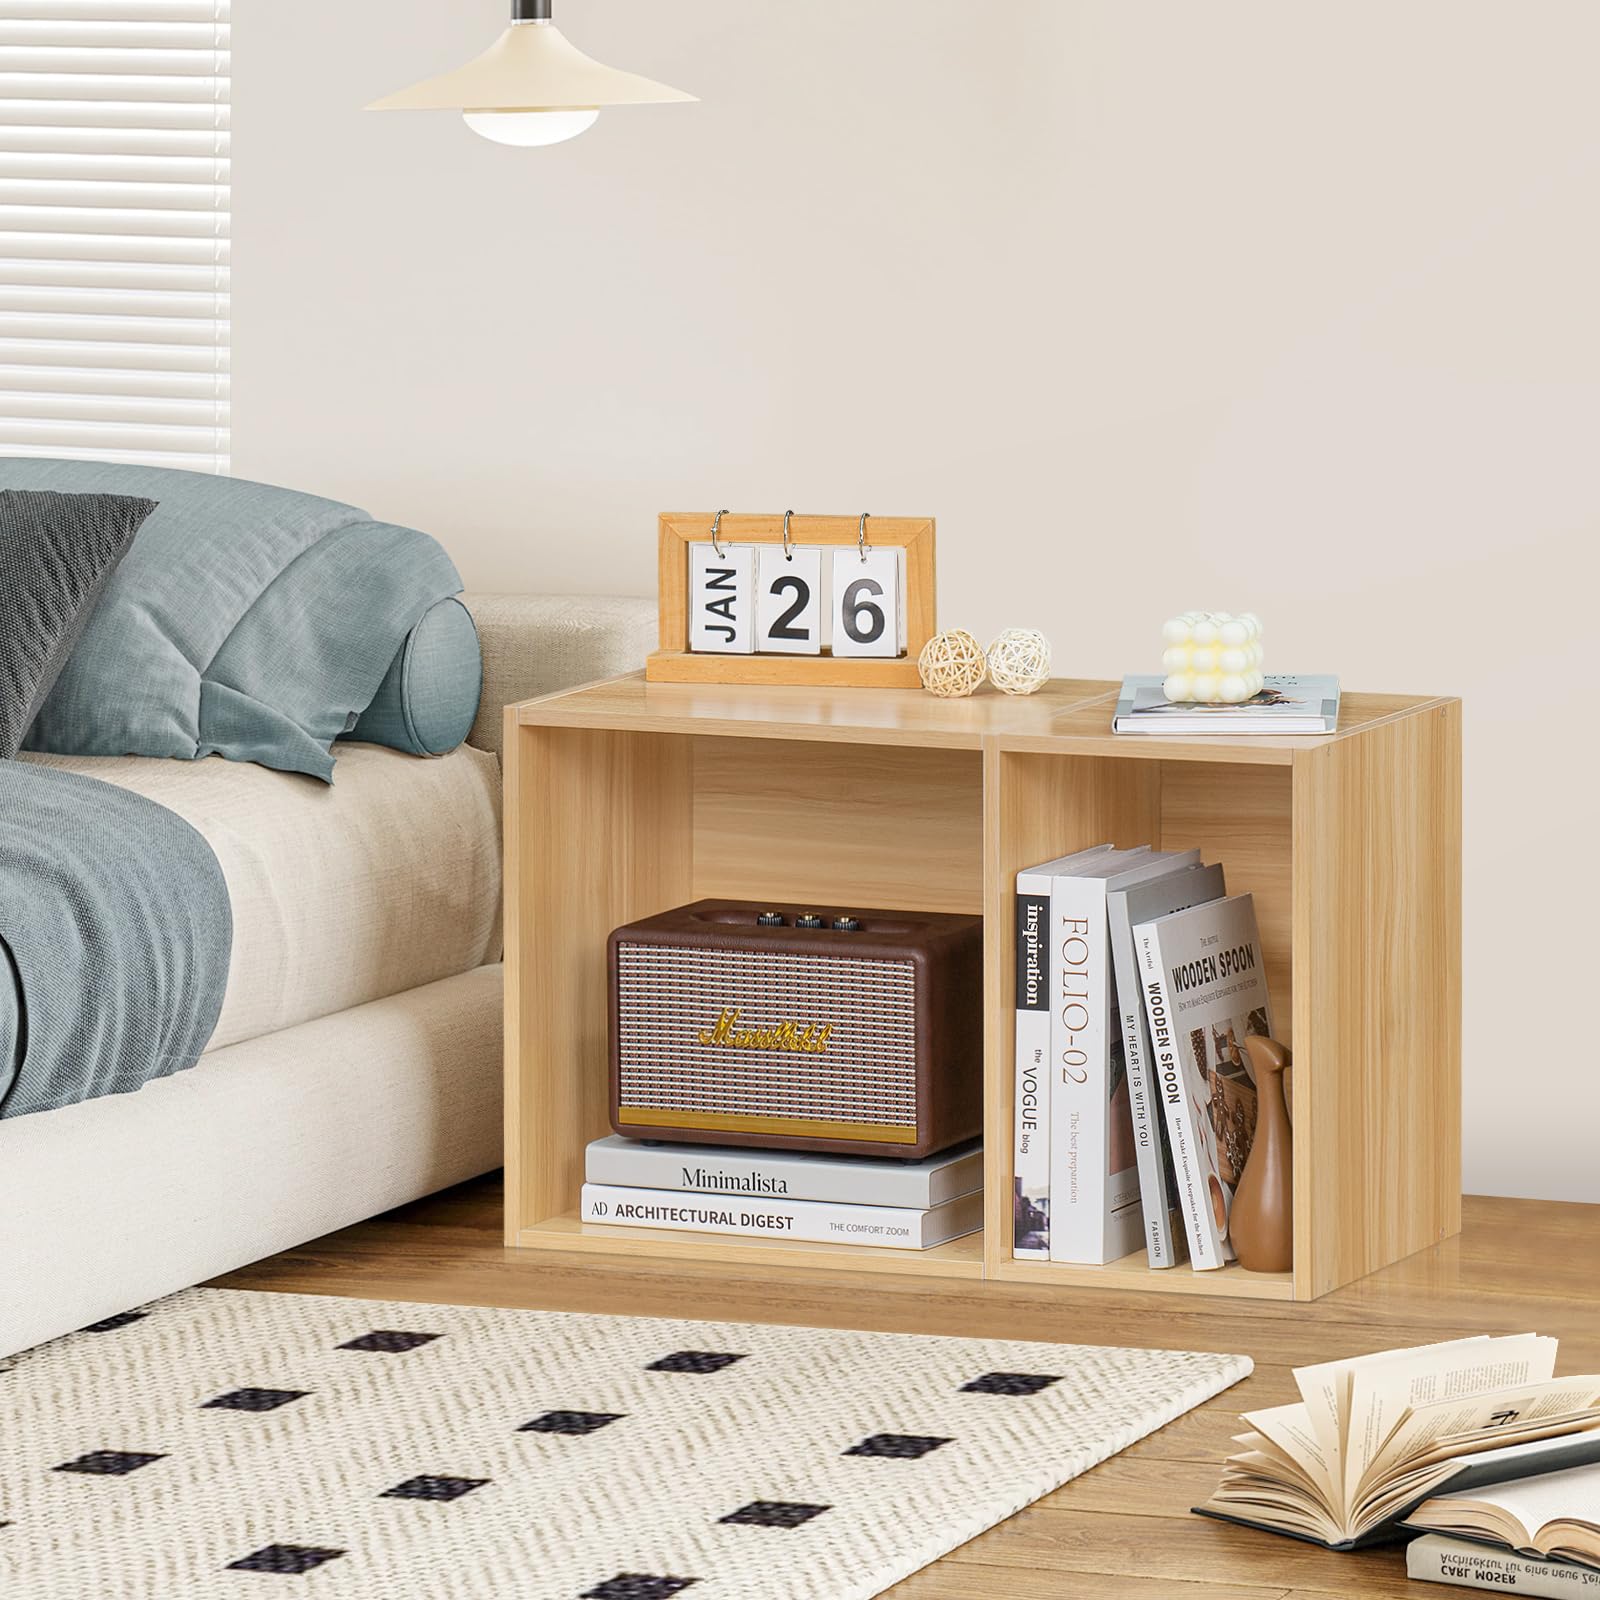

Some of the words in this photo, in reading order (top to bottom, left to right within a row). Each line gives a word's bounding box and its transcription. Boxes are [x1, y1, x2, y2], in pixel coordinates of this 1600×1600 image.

[704, 567, 737, 643] JAN
[1022, 904, 1044, 1005] inspiration
[1172, 955, 1218, 993] WOODEN
[1219, 943, 1255, 978] SPOON
[1062, 916, 1089, 1084] FOLIO-02
[1126, 1015, 1136, 1030] MY
[1034, 1049, 1043, 1063] the
[1128, 1035, 1141, 1072] HEART
[1148, 982, 1170, 1048] WOODEN
[1160, 1053, 1181, 1104] SPOON
[1133, 1075, 1142, 1087] IS
[1022, 1067, 1038, 1130] VOGUE
[1135, 1092, 1146, 1120] WITH
[1070, 1112, 1080, 1130] The
[1020, 1134, 1030, 1154] blog
[1070, 1132, 1080, 1151] best
[1139, 1124, 1149, 1147] YOU
[682, 1167, 789, 1194] Minimalista
[1068, 1152, 1080, 1204] preparation
[591, 1201, 608, 1216] AD
[615, 1204, 737, 1226] ARCHITECTURAL
[740, 1213, 794, 1230] DIGEST
[829, 1222, 845, 1232] THE
[846, 1223, 884, 1235] COMFORT
[885, 1226, 909, 1236] ZOOM
[1151, 1221, 1161, 1258] FASHION
